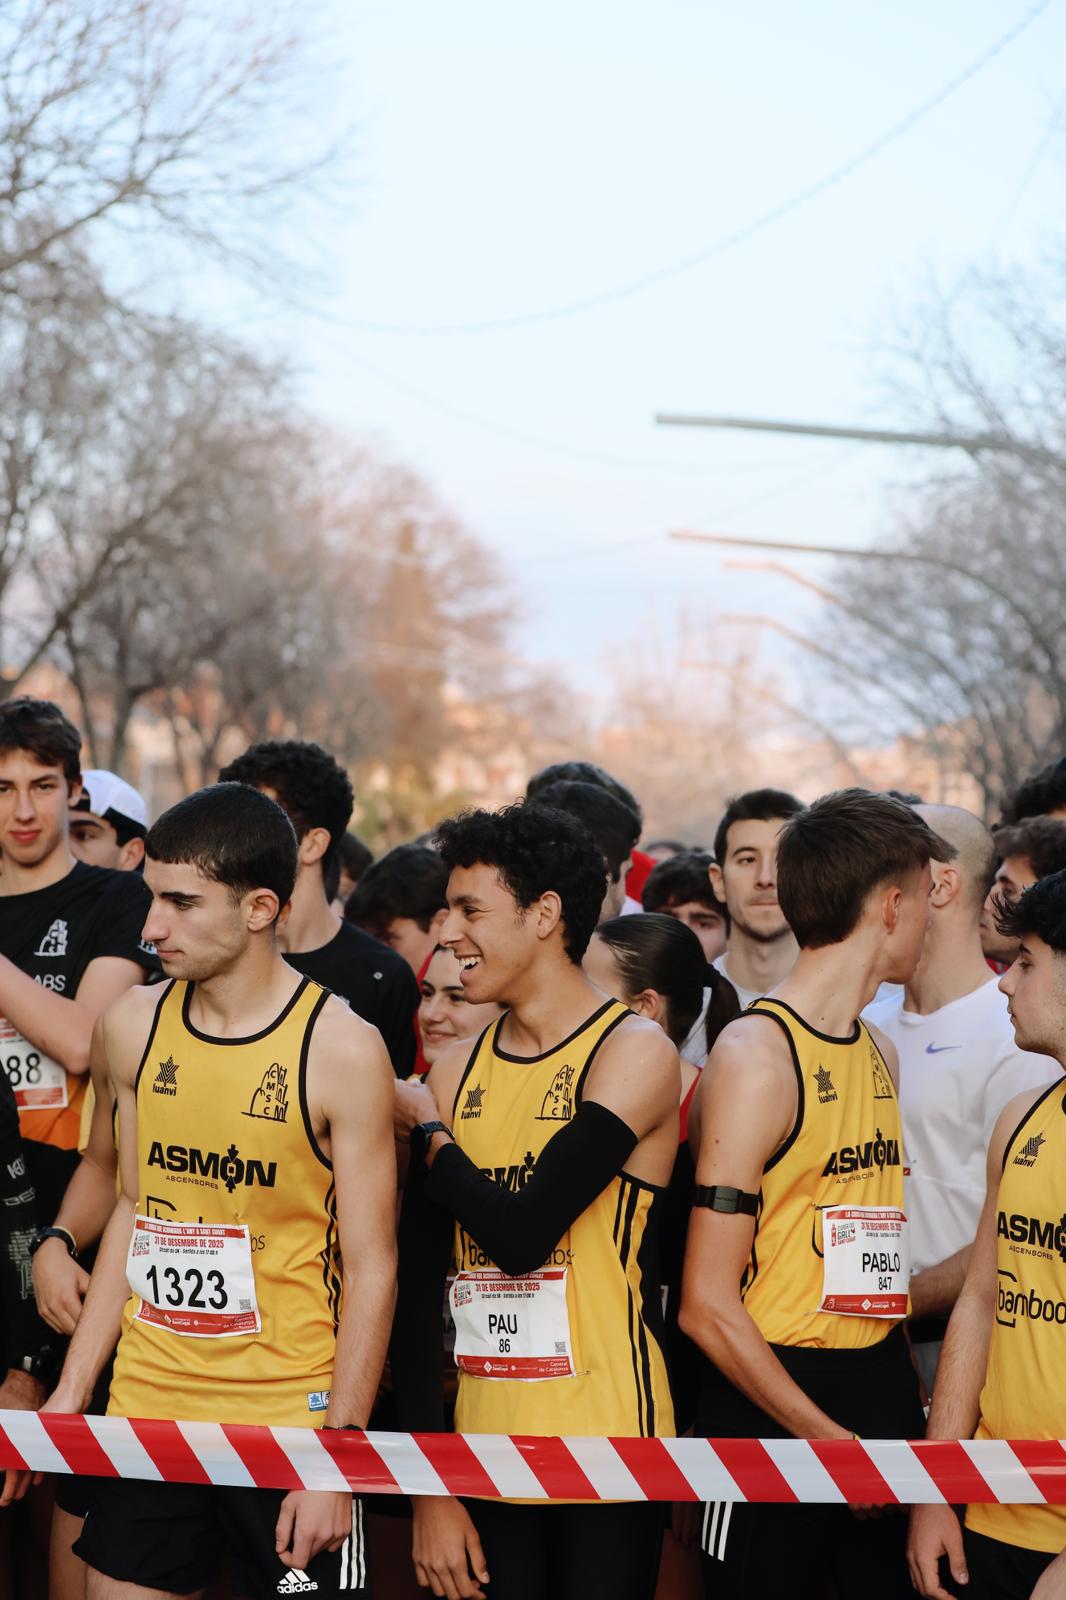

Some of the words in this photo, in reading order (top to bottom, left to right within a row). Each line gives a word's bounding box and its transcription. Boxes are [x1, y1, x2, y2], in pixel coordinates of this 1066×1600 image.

[152, 1083, 177, 1097] luanvi
[818, 1091, 838, 1104] luanvi
[461, 1108, 481, 1119] luanvi
[147, 1141, 277, 1190] ASMON
[1013, 1155, 1036, 1168] luanvi
[165, 1175, 219, 1190] ASCENSORES
[997, 1211, 1066, 1255] ASMO
[154, 1236, 160, 1245] 31
[160, 1237, 167, 1246] DE
[168, 1238, 198, 1247] DESEMBRE
[200, 1239, 206, 1248] DE
[208, 1240, 224, 1248] 2025
[1008, 1245, 1053, 1261] ASCENSORES
[862, 1252, 900, 1272] PABLO
[146, 1265, 228, 1310] 1323
[482, 1283, 488, 1291] DE
[490, 1283, 515, 1291] DESEMBRE
[517, 1283, 524, 1291] DE
[525, 1282, 540, 1291] 2025
[878, 1276, 892, 1290] 847
[488, 1314, 518, 1334] PAU
[499, 1338, 510, 1352] 86
[276, 1581, 319, 1594] adidas
